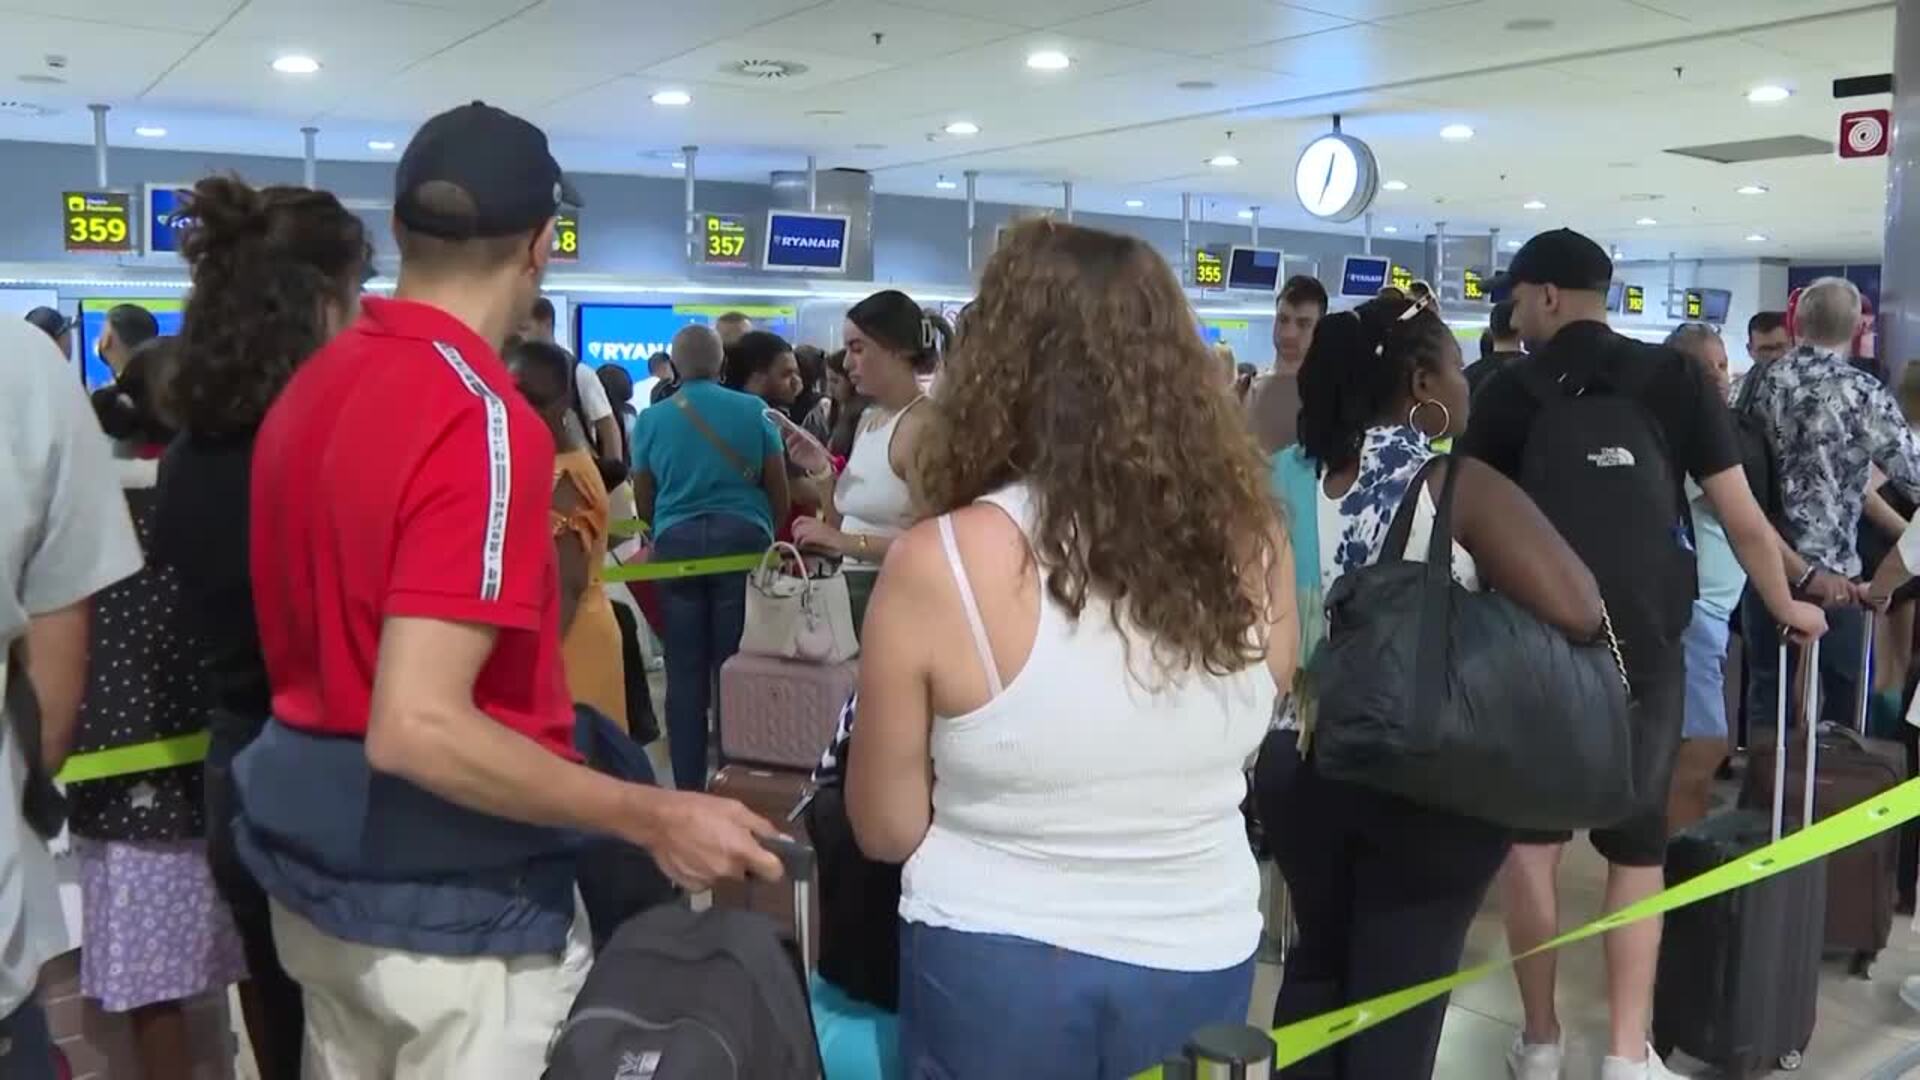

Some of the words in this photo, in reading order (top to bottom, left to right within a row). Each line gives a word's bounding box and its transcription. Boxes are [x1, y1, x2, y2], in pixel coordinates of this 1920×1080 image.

[70, 217, 126, 242] 359
[709, 236, 744, 255] 357
[781, 236, 840, 248] RYANAIR
[1198, 266, 1221, 282] 355
